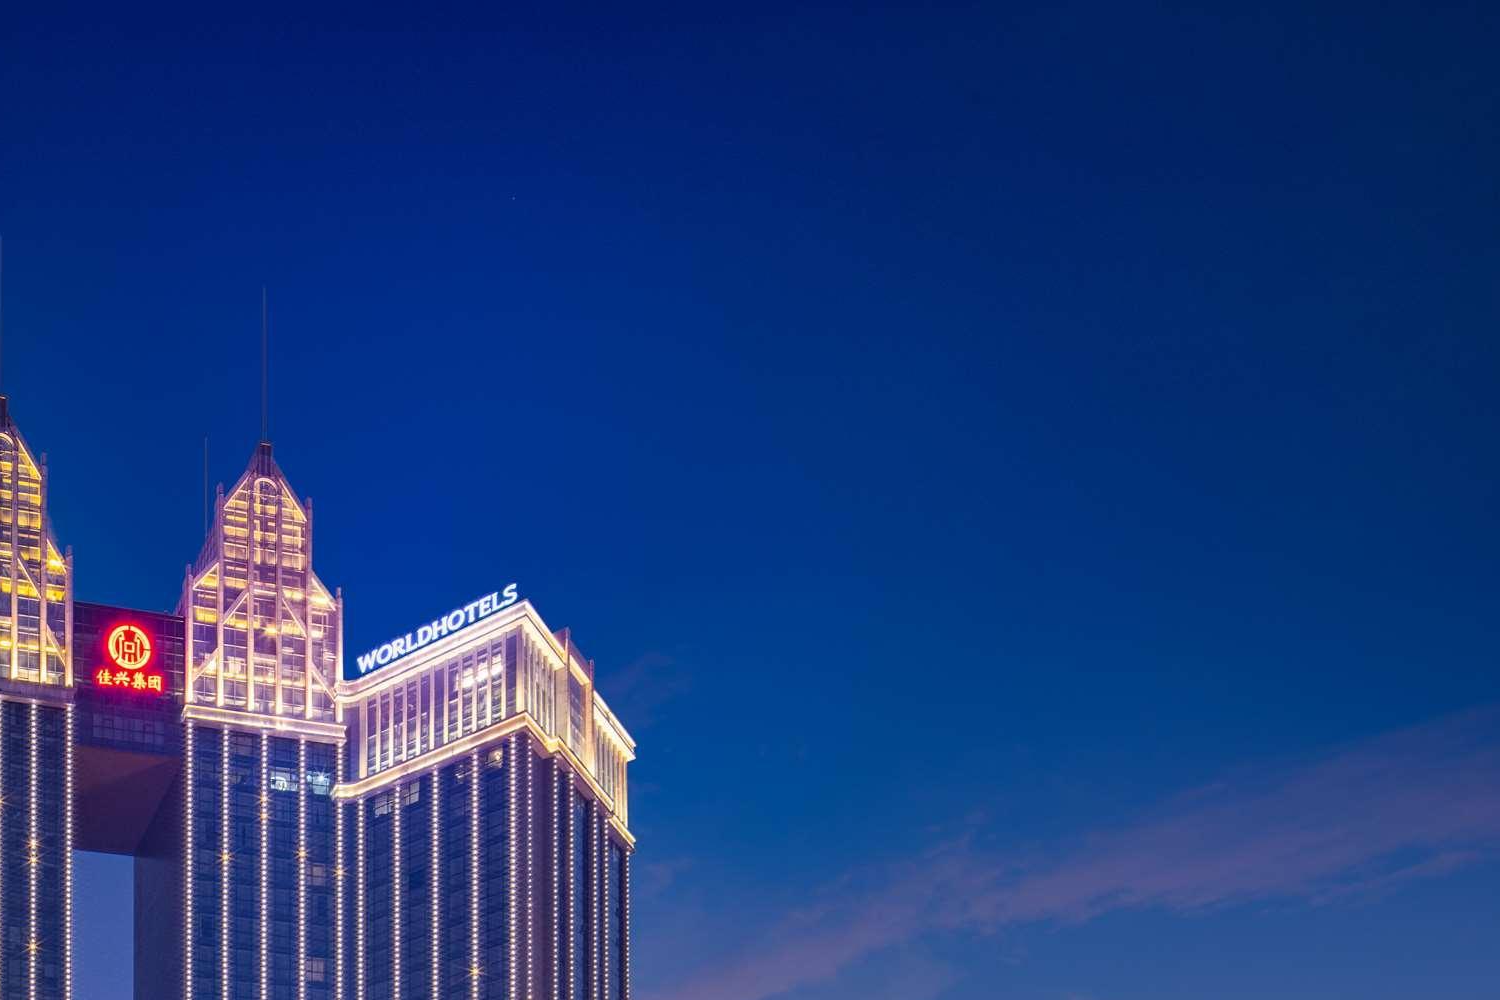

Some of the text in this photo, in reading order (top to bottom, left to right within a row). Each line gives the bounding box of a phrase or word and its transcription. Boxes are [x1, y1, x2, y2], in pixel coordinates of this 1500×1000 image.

[356, 583, 518, 673] WORLDHOTELS
[96, 668, 162, 691] 佳兴集团
